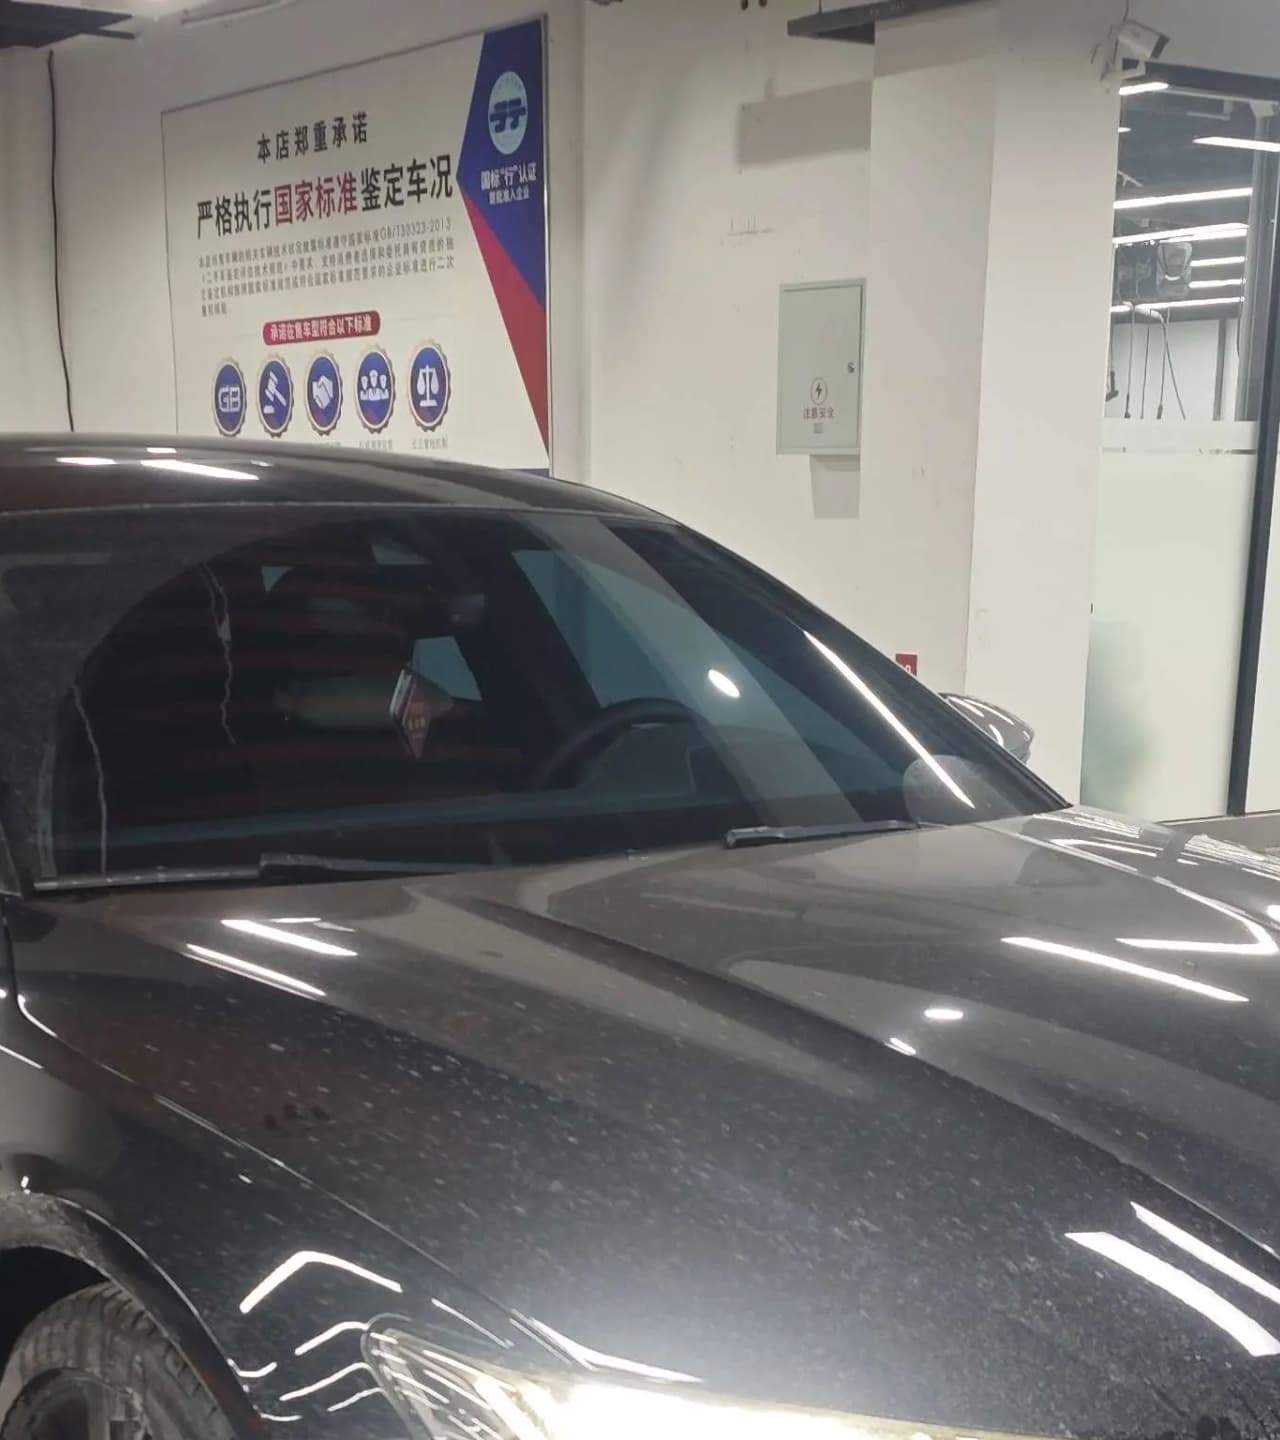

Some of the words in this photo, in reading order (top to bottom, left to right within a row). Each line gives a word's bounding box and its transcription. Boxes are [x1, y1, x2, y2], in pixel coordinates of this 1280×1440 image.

[257, 112, 368, 164] 本店郑重承诺
[197, 154, 453, 239] 严格执行国家标准鉴定车况
[218, 385, 240, 413] GB
